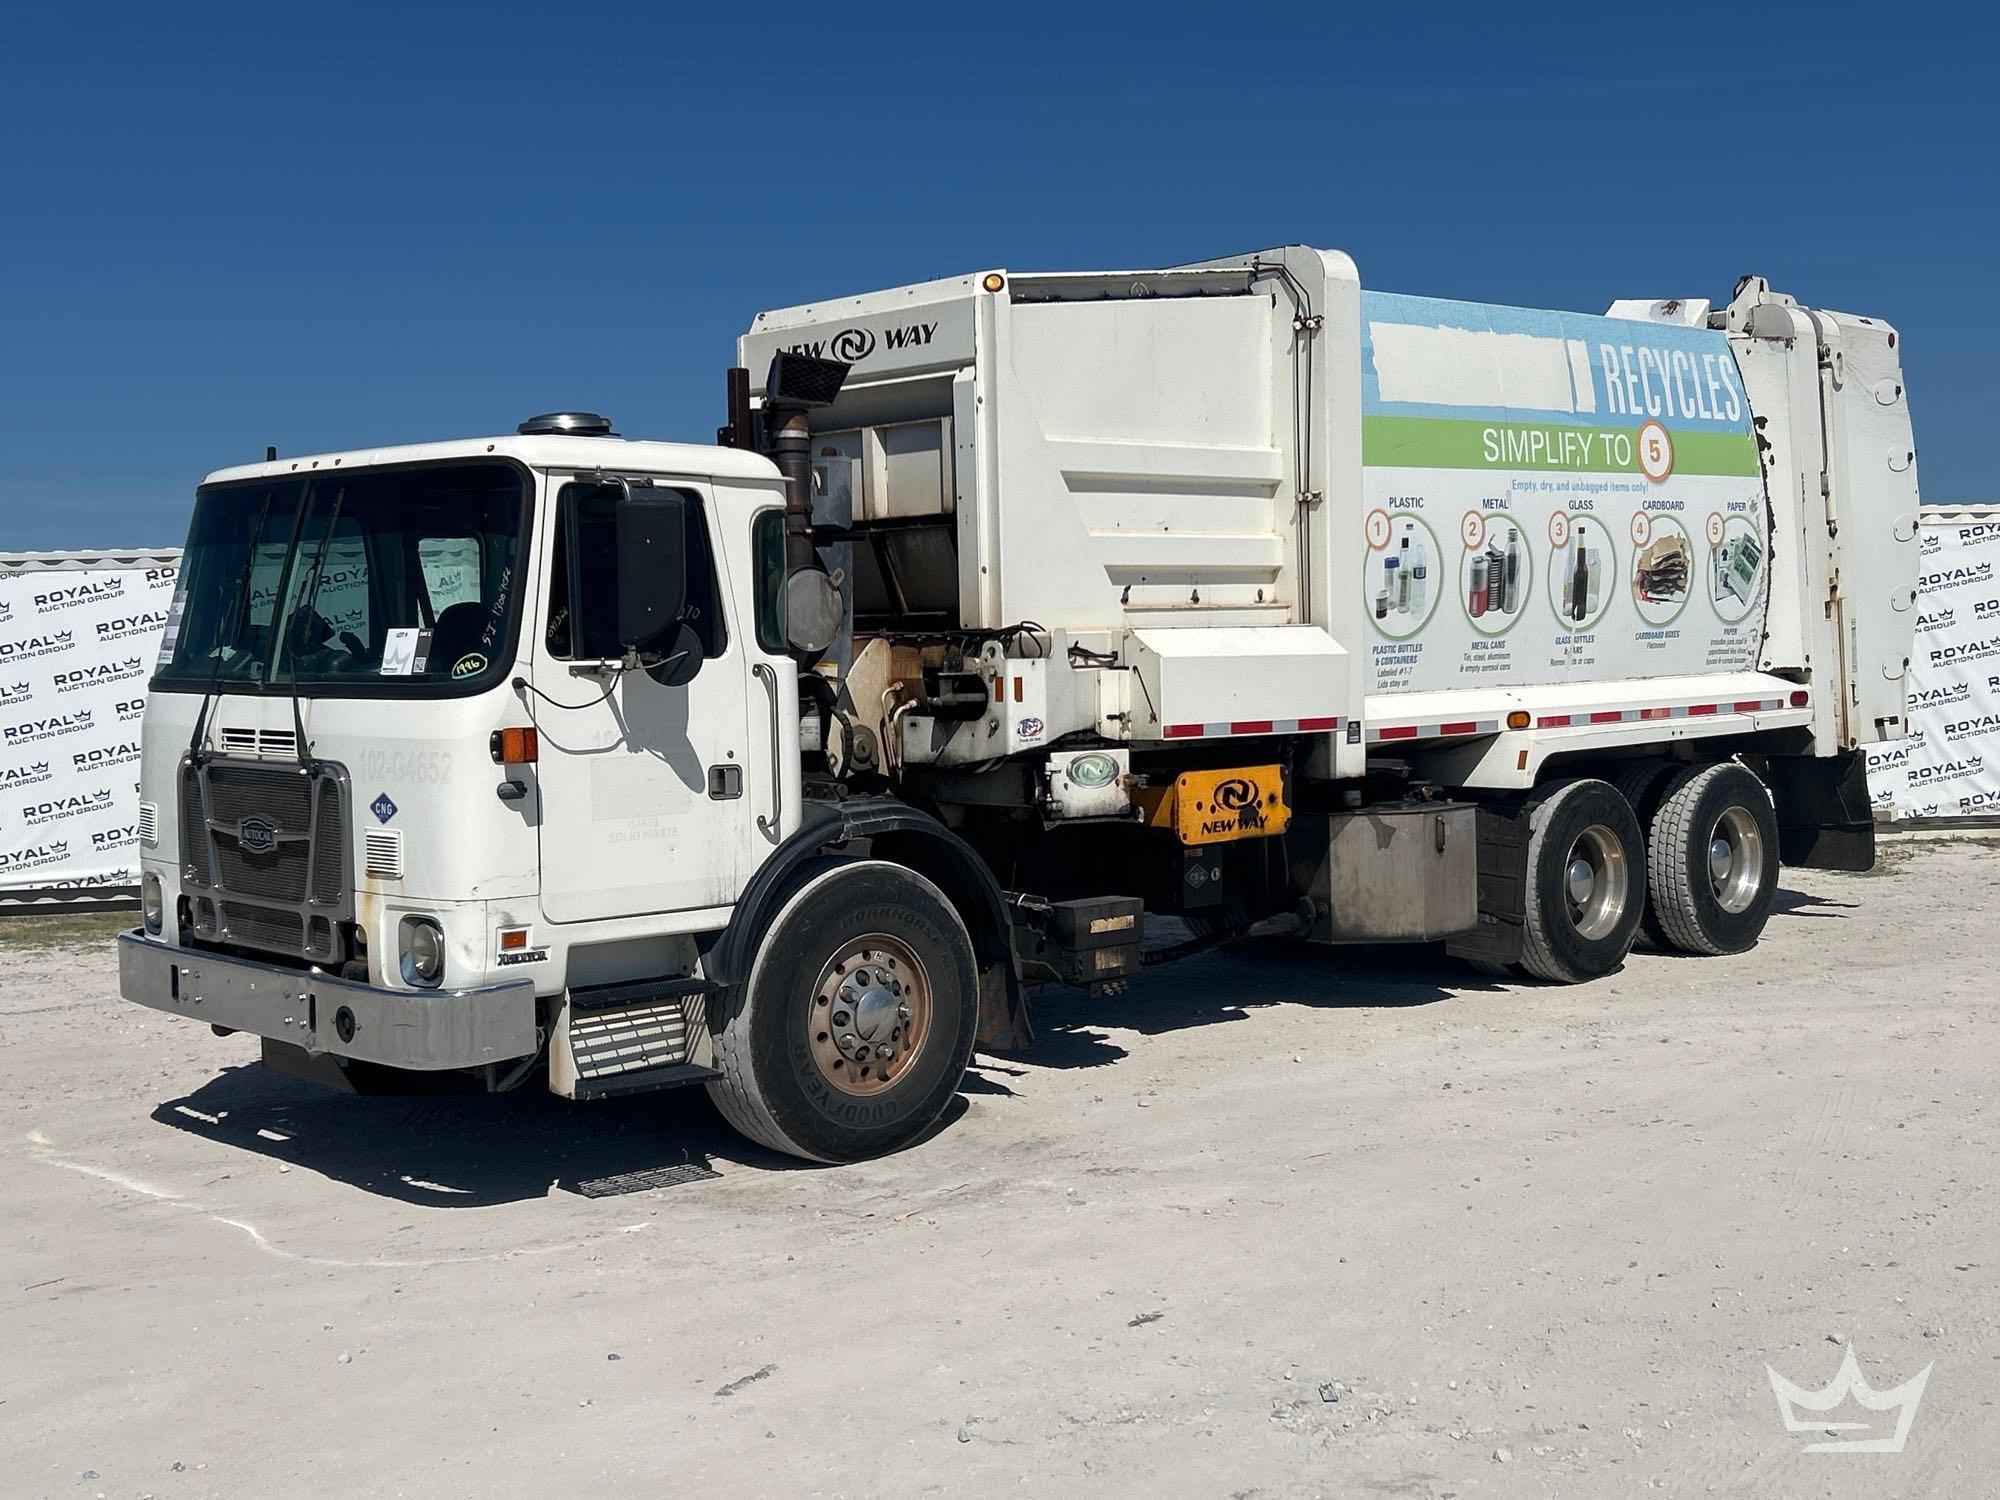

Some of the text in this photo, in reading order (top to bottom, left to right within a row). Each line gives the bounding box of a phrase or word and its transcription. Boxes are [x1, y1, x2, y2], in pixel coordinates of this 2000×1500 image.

[885, 322, 938, 350] WAY
[1600, 344, 1741, 422] RECYCLES
[1483, 428, 1661, 465] SIMPLIFY TO 5
[1512, 480, 1649, 494] Empty, dry, and unbagged items only!
[1389, 497, 1424, 509] PLASTIC
[1482, 499, 1508, 509] METAL
[1568, 500, 1594, 510] GLASS
[1642, 500, 1685, 511] CARDBOARD
[1727, 502, 1746, 512] PAPER
[1469, 522, 1477, 536] 2
[1556, 522, 1563, 536] 3
[1636, 522, 1644, 536] 4
[1712, 523, 1719, 535] 5
[1959, 524, 2000, 539] ROY
[1921, 547, 1942, 556] OUP
[149, 579, 178, 590] AUCT
[1919, 567, 1976, 587] ROYAL
[1919, 573, 1994, 595] AUCTION GROUP
[34, 583, 104, 606] ROYAL
[38, 591, 125, 614] AUCTION GROUP
[96, 610, 166, 634] ROYAL
[1977, 612, 2000, 620] AUCT
[1924, 620, 1956, 633] GROUP
[100, 627, 148, 642] AUCTION
[1555, 636, 1571, 645] GLASS
[0, 635, 54, 655] OYAL
[1372, 643, 1423, 655] PLASTIC BOTTLES
[1471, 640, 1506, 650] METAL CANS
[1571, 646, 1583, 654] ARS
[1930, 641, 1990, 661] ROYAL
[0, 642, 76, 665] CTION GROUP
[1381, 655, 1417, 666] CONTAINERS
[1933, 649, 2000, 668] AUCTION GROU
[53, 663, 124, 686] ROYAL
[1377, 668, 1398, 678] Labeled
[57, 669, 145, 693] AUCTION GROUP
[1377, 679, 1409, 689] Lids stay on
[1908, 688, 1953, 704] OYAL
[1908, 694, 1970, 712] CTION GROUP
[3, 715, 75, 739] ROYAL
[7, 722, 95, 747] AUCTION GROUP
[1947, 728, 1989, 742] AUCTION
[73, 742, 141, 765] ROYAL
[76, 759, 124, 773] AUCTION
[1908, 761, 1967, 781] ROYAL
[14, 773, 53, 788] GROUP
[1909, 767, 1984, 789] AUCTION GROUP
[22, 795, 94, 818] ROYAL
[1960, 791, 2000, 807] ROY
[26, 801, 114, 826] AUCTION GROUP
[375, 802, 393, 816] CNG
[1201, 818, 1236, 835] NEW
[0, 846, 51, 866] OYAL
[0, 853, 72, 874] CTION GROUP
